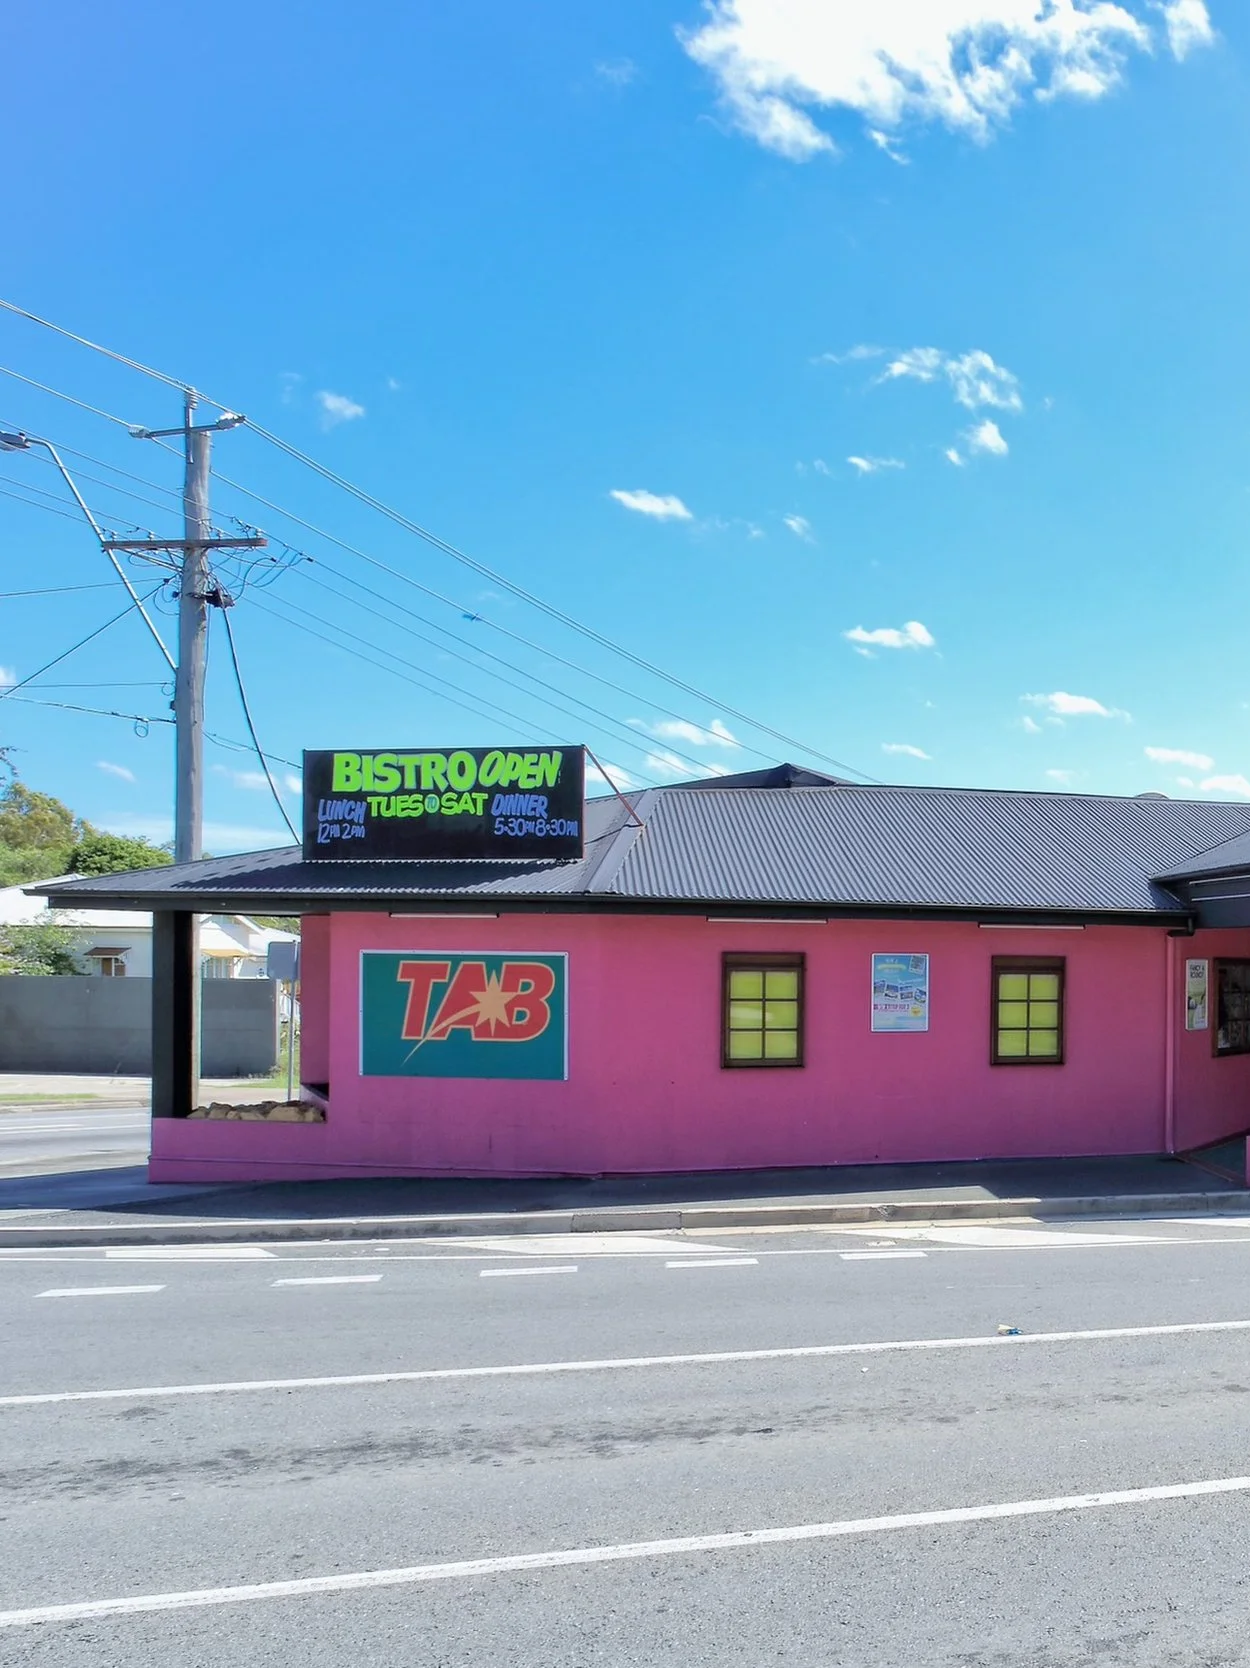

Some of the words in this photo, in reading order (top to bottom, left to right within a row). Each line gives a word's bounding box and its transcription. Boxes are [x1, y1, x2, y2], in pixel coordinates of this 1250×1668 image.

[331, 750, 477, 792] BISTRO
[478, 750, 562, 789] OPEN
[317, 798, 368, 824] LUNCH
[366, 793, 424, 817] TUES
[440, 792, 489, 816] SAT
[491, 793, 548, 819] DINNER
[396, 960, 556, 1043] TAB
